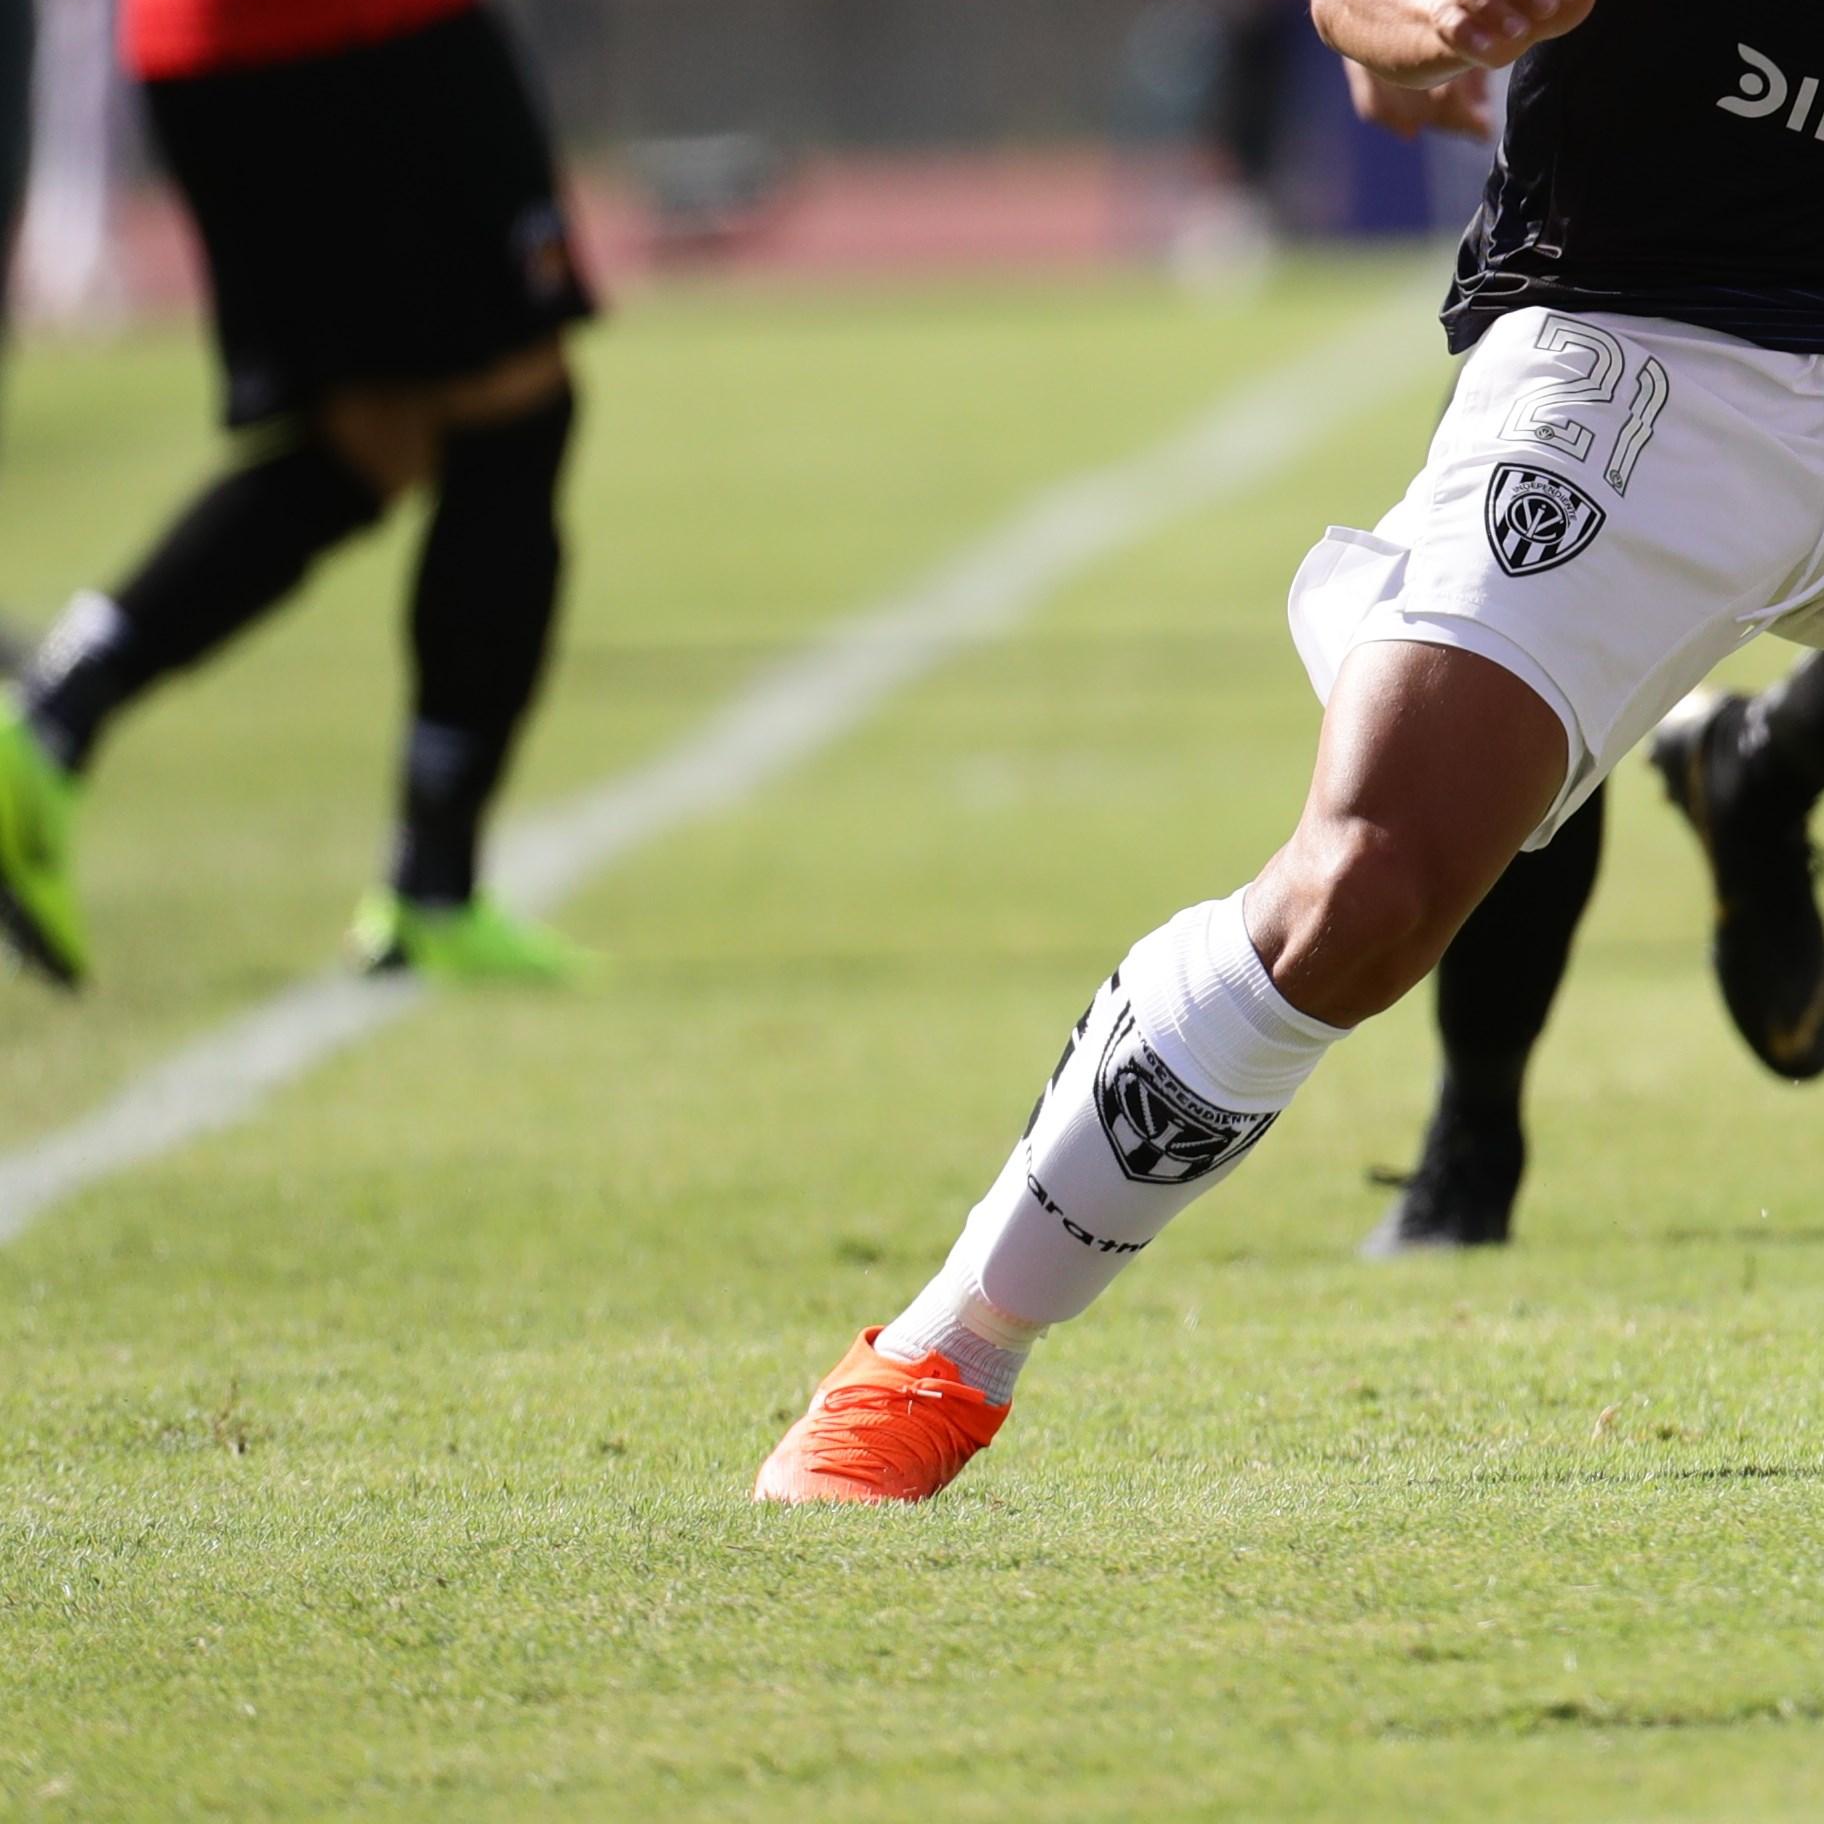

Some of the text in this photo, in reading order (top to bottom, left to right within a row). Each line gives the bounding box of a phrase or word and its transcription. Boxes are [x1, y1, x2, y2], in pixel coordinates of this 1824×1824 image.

[1498, 314, 1669, 498] 21
[1512, 482, 1577, 521] INDEPENDIENTE
[1139, 1031, 1260, 1125] NDEPENDIENTE
